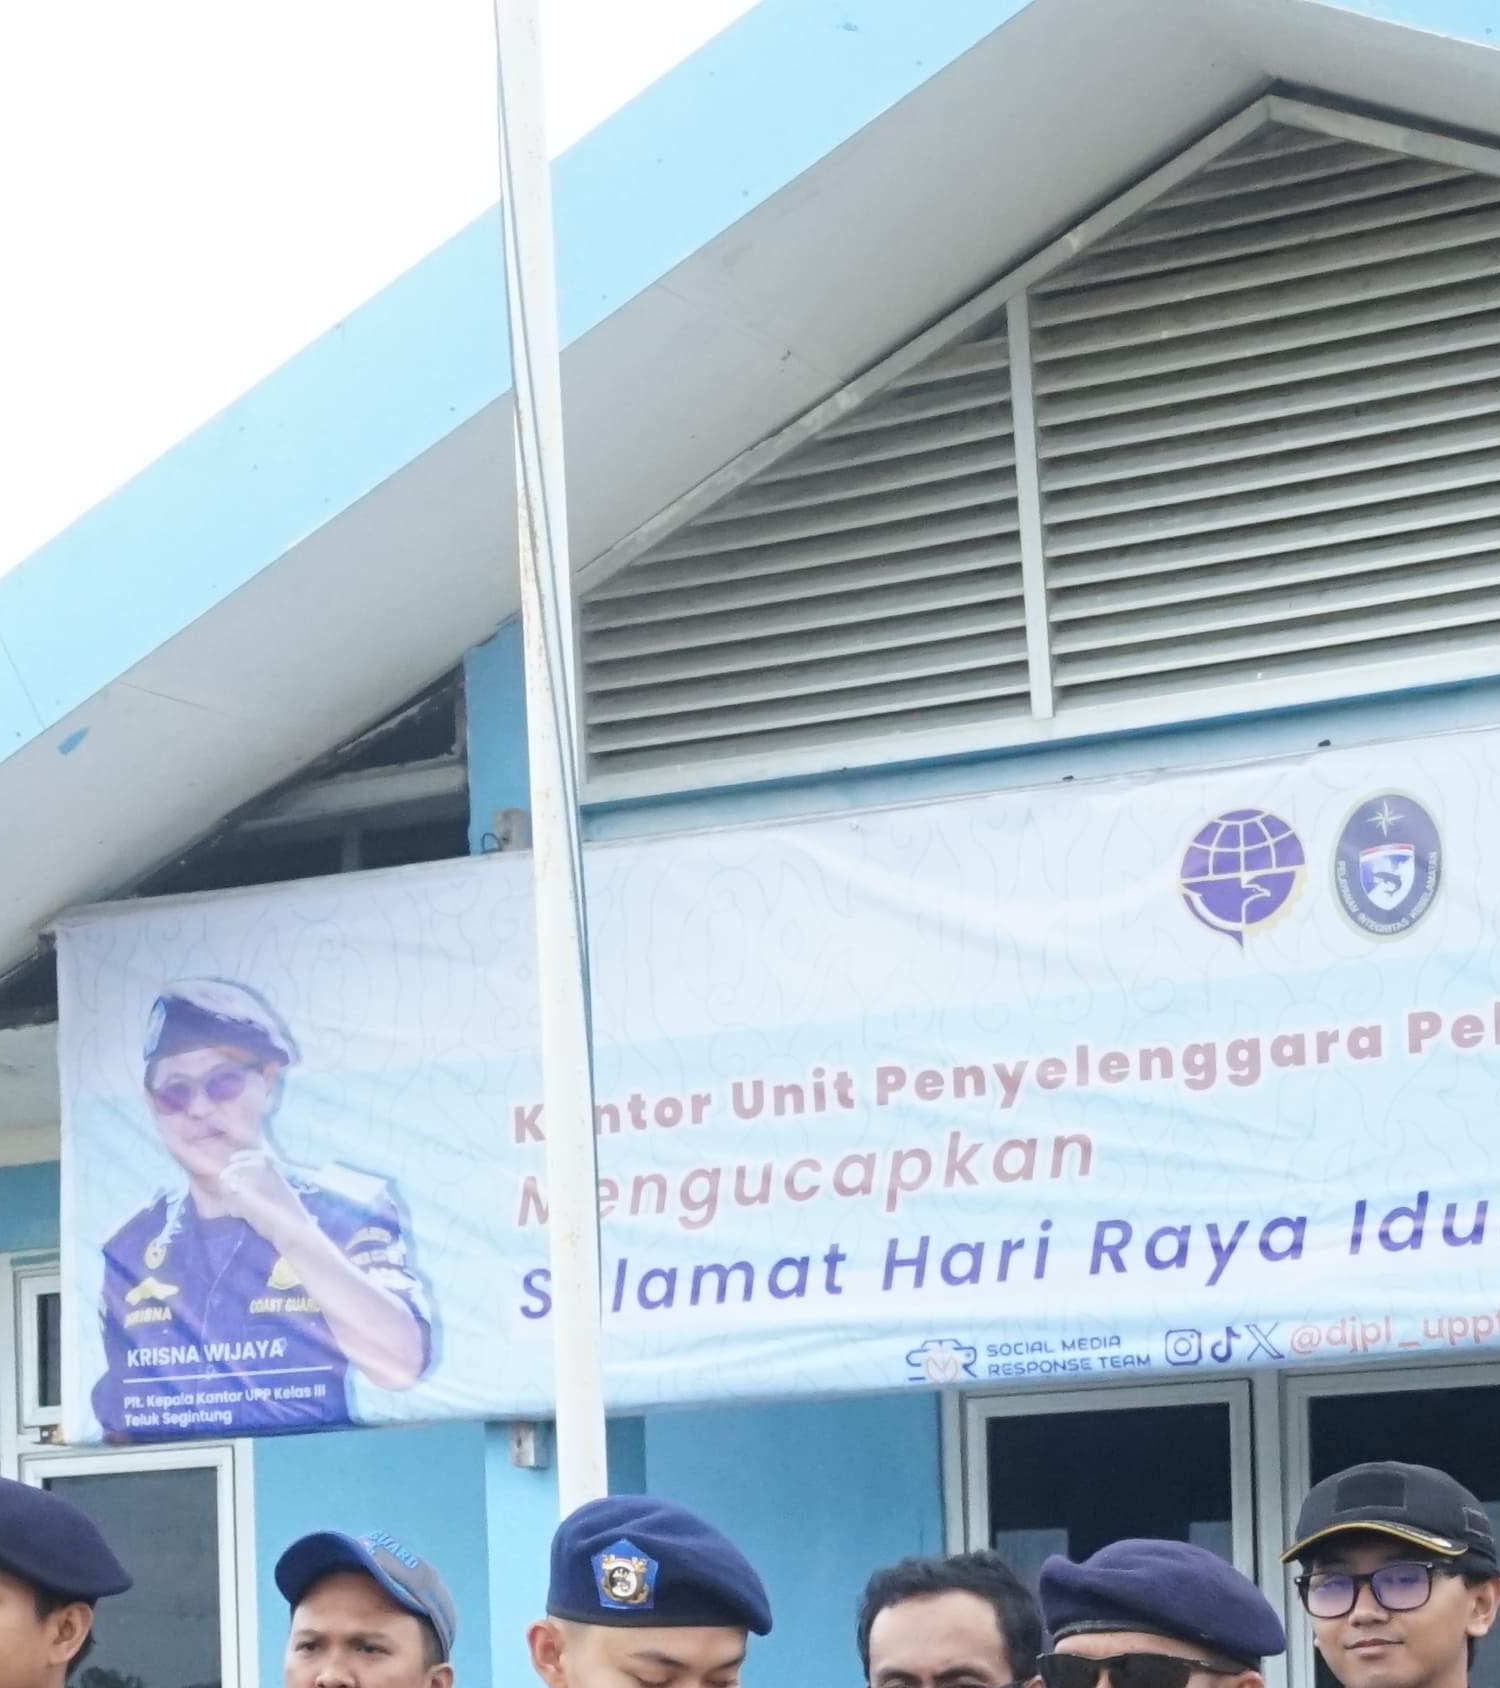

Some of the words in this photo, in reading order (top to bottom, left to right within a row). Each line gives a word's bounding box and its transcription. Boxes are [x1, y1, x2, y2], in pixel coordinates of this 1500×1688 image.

[514, 1090, 713, 1144] Kntor
[731, 1067, 856, 1120] Unit
[875, 1024, 1384, 1110] Penyelenggara
[519, 1243, 848, 1320] Slamat
[881, 1218, 1054, 1292] Hari
[1088, 1215, 1308, 1288] Raya
[127, 1345, 200, 1368] KRISNA
[203, 1338, 284, 1362] WIJAYA
[986, 1341, 1054, 1357] SOCIAL
[1061, 1335, 1122, 1351] MEDIA
[987, 1358, 1093, 1376] RESPONSE
[1099, 1354, 1151, 1369] TEAM
[146, 1393, 194, 1410] Kepala
[196, 1390, 243, 1406] Kantor
[245, 1388, 271, 1401] UPP
[274, 1385, 312, 1400] Kelas
[123, 1412, 159, 1427] Teluk
[162, 1410, 233, 1428] Segintung
